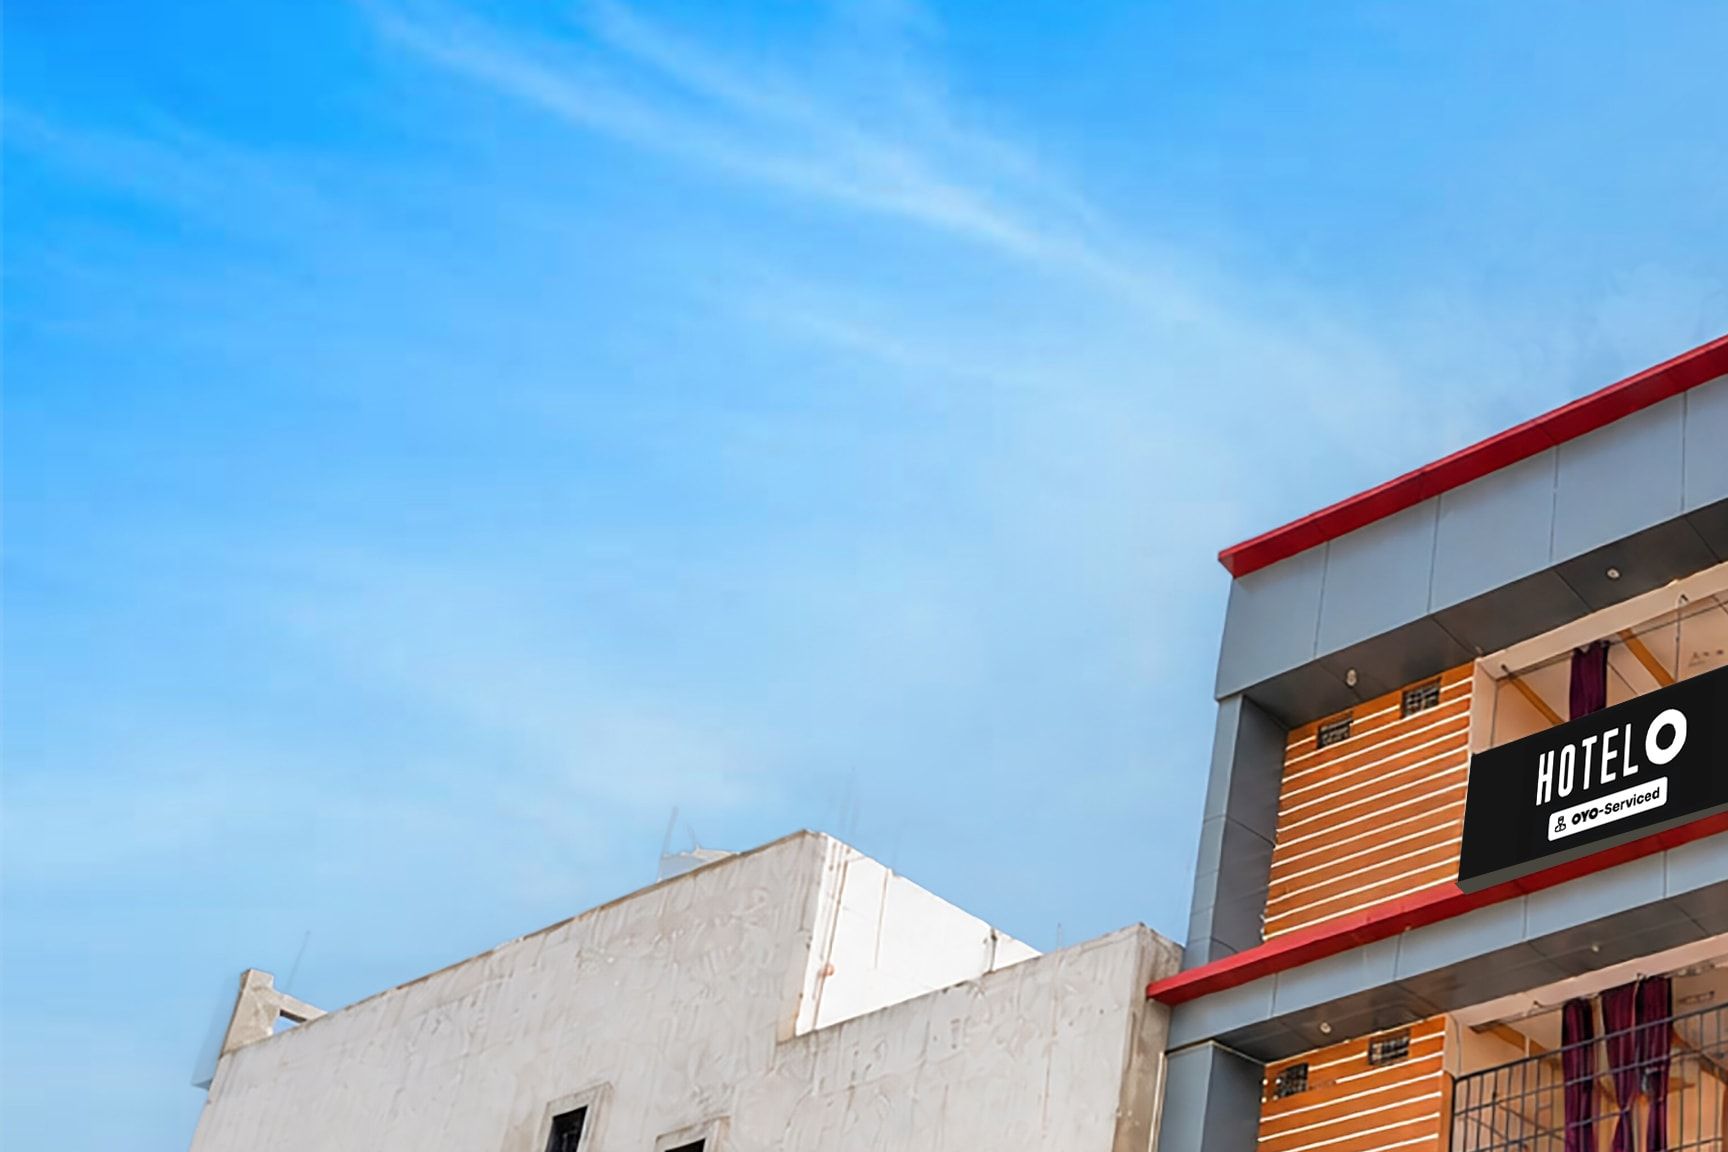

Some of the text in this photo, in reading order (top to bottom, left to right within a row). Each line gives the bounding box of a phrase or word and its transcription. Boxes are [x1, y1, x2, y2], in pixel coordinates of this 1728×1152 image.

[1536, 708, 1687, 805] HOTEL O
[1571, 787, 1660, 825] OYO-Serviced
